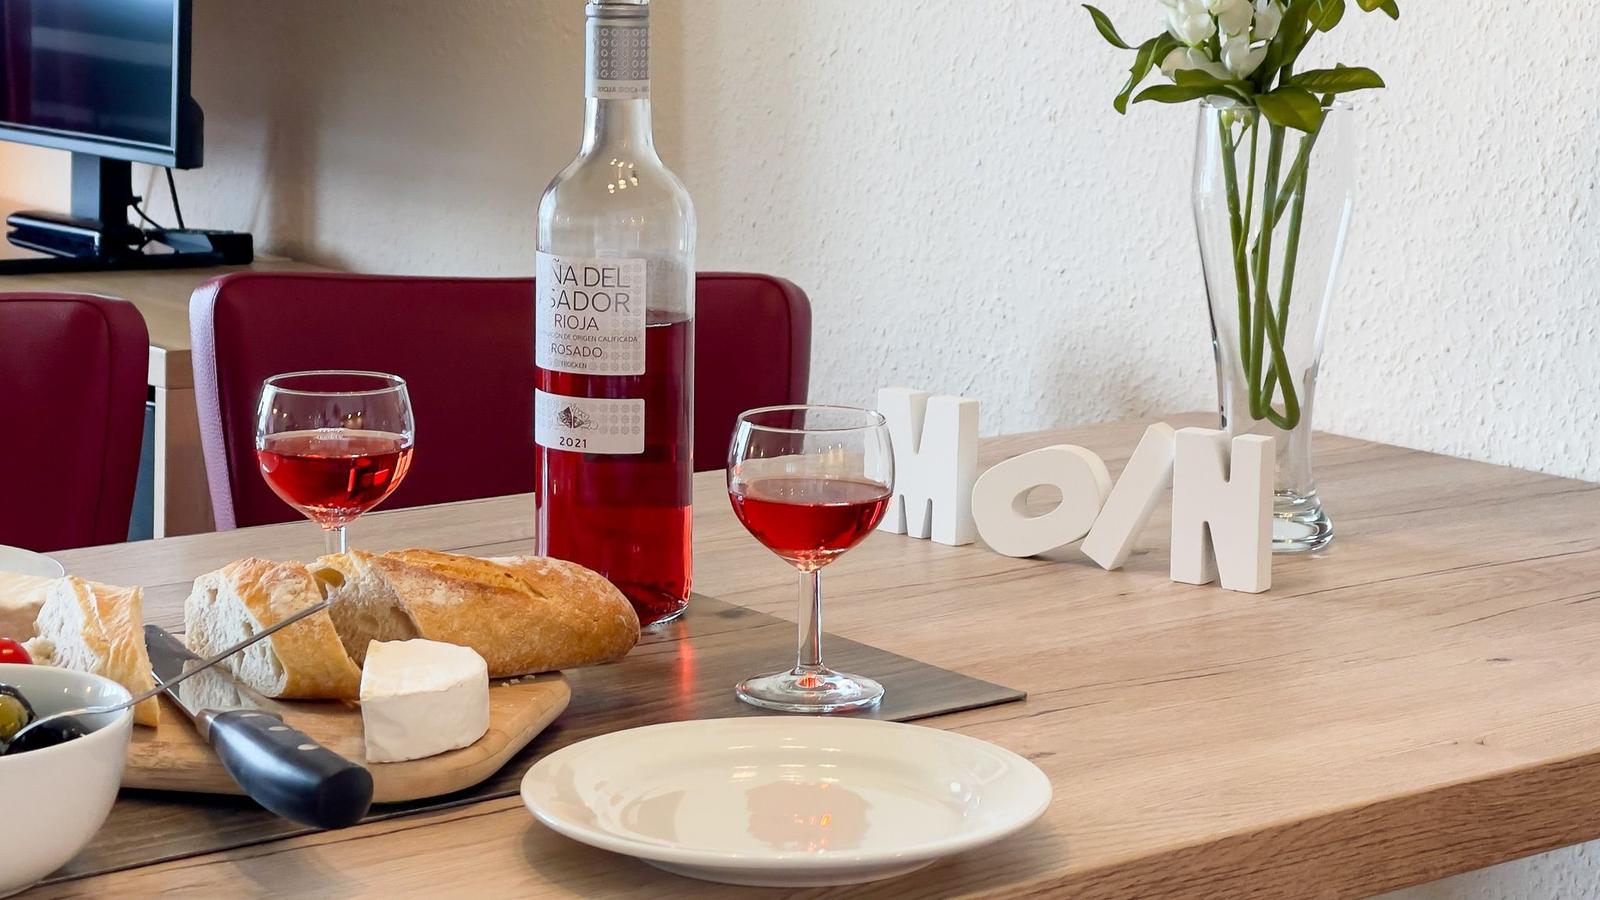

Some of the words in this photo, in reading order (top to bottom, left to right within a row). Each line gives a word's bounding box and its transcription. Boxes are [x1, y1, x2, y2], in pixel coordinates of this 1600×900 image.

[583, 266, 631, 288] DEL
[554, 313, 599, 331] RIOJA
[572, 334, 597, 342] ORIGEN
[597, 335, 638, 343] CALIFICADA
[551, 342, 603, 358] ROSADO
[560, 360, 587, 369] TROCKEN
[559, 436, 588, 449] 2021
